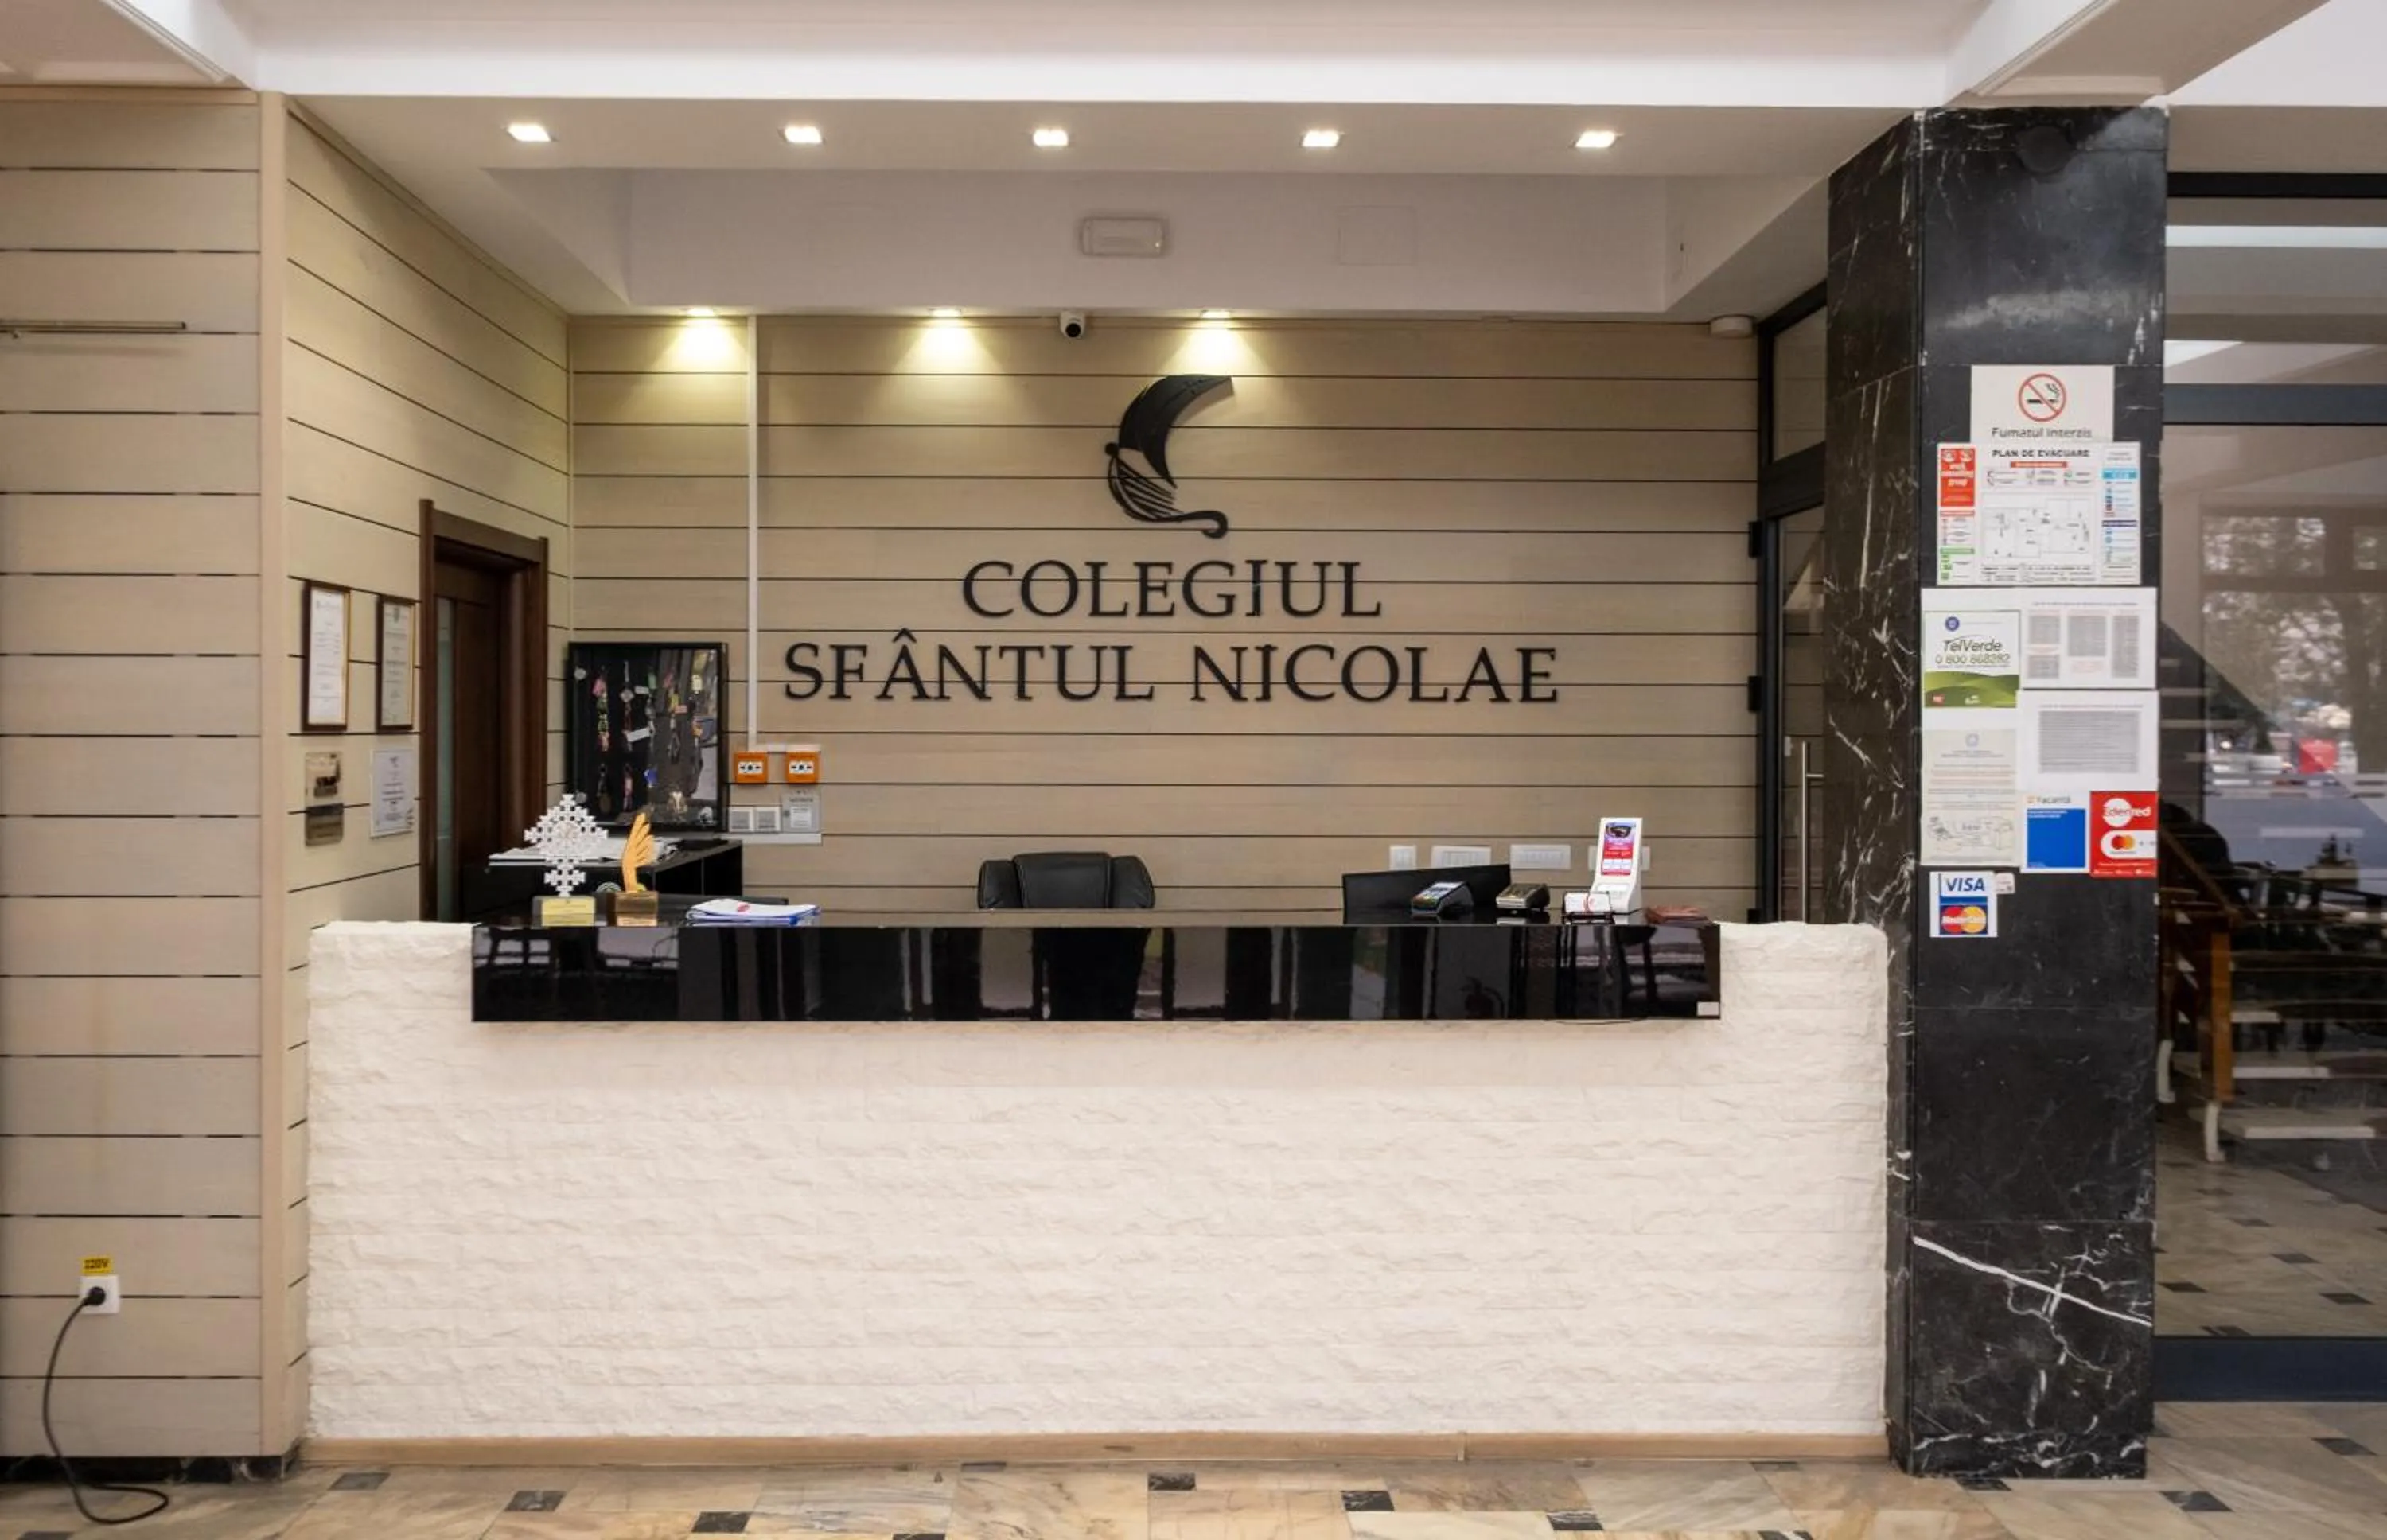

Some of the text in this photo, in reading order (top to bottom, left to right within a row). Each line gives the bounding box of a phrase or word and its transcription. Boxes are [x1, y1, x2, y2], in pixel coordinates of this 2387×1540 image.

[1991, 426, 2044, 438] Fumatul
[962, 559, 1382, 618] COLEGIUL
[1943, 637, 2003, 651] TelVerde
[784, 628, 1559, 703] SFÂNTUL NICOLAE
[1946, 877, 1986, 892] VISA
